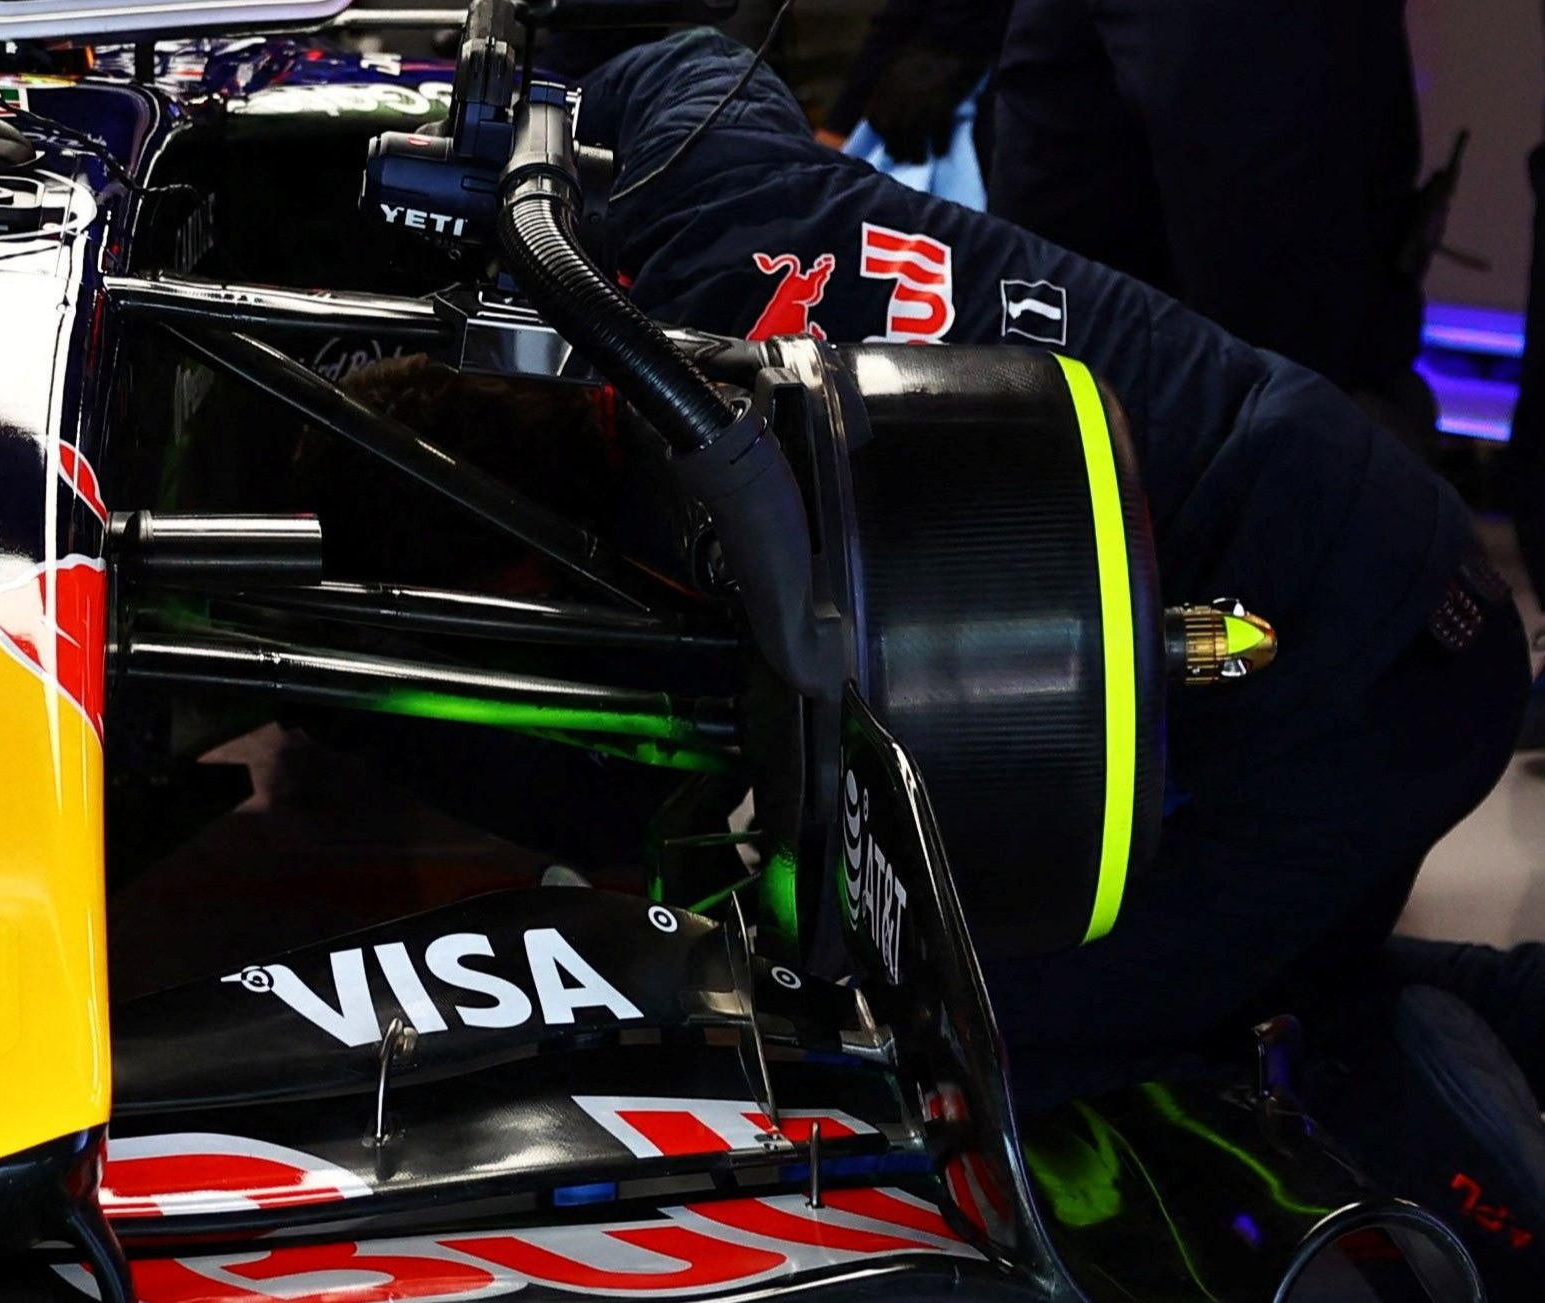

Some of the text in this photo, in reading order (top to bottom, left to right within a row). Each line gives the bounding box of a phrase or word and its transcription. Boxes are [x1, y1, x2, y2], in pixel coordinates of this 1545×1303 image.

[380, 202, 465, 238] YETI
[864, 832, 908, 986] AT&T
[221, 927, 645, 1048] VISA
